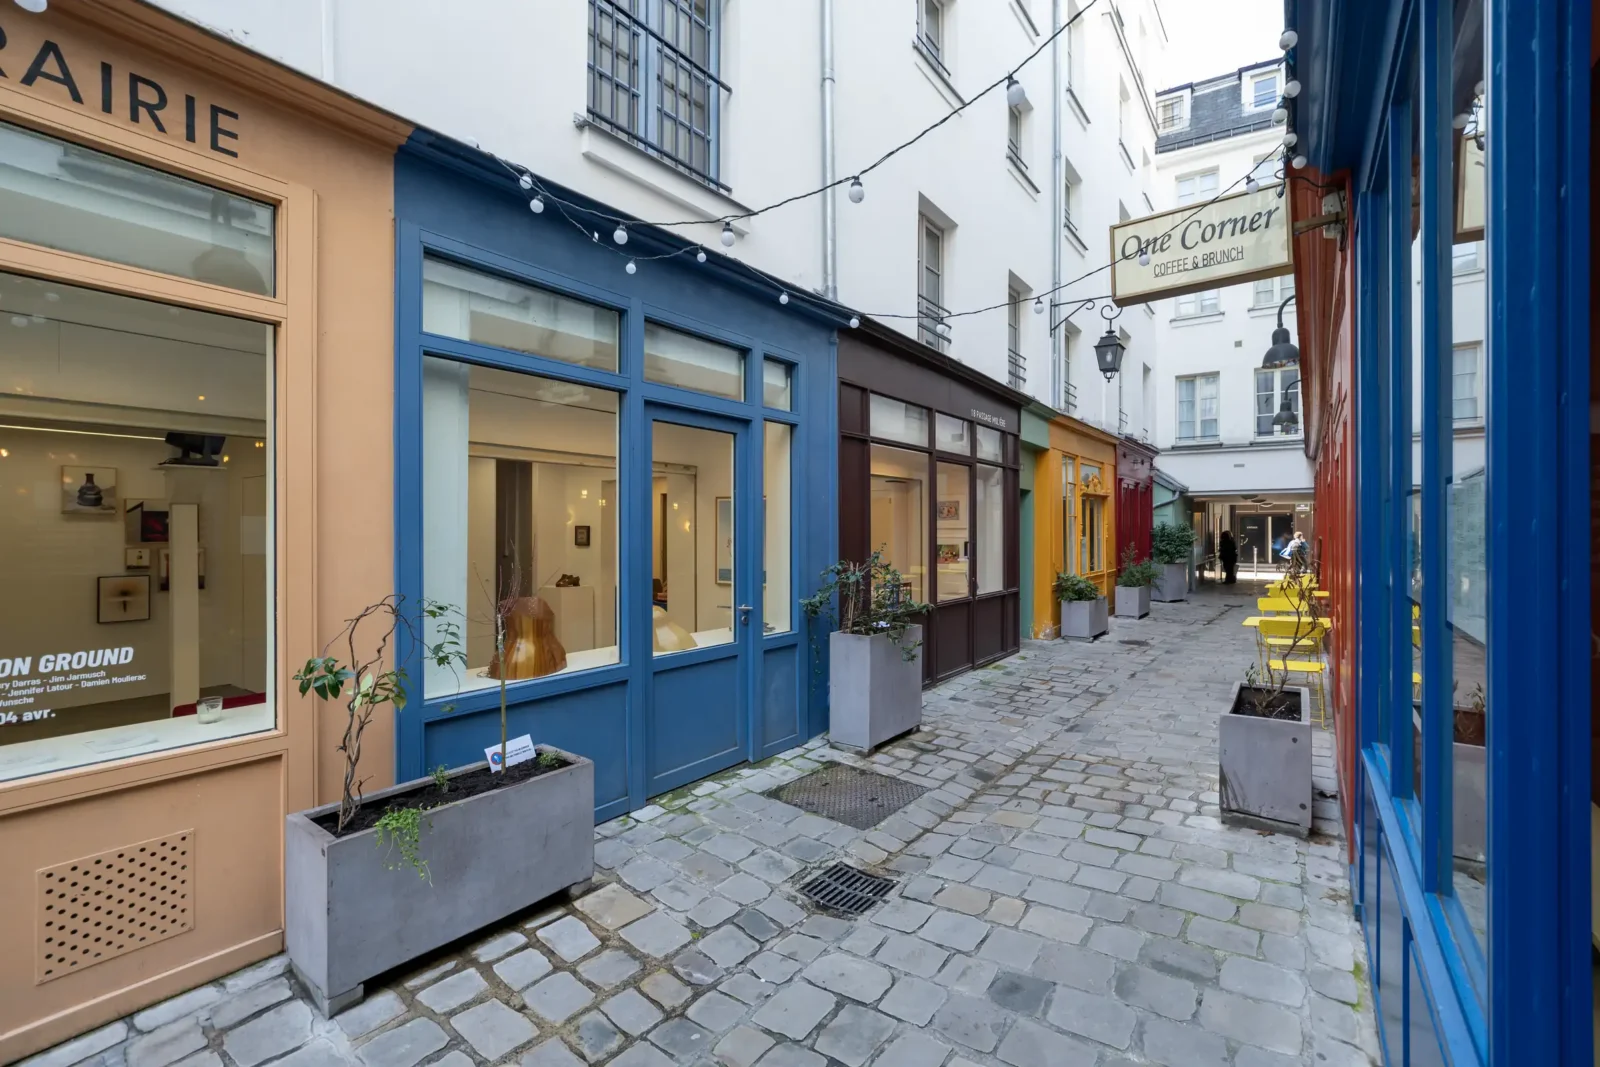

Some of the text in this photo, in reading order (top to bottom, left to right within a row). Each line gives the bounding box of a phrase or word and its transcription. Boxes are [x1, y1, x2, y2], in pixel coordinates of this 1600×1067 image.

[1121, 206, 1280, 261] One Corner
[1153, 246, 1244, 277] COFFEE & BRUNCH
[0, 647, 134, 678] ON GROUND
[8, 687, 45, 697] Jennifer
[46, 683, 73, 693] Latour
[81, 678, 110, 688] Damien
[12, 679, 41, 688] Darras
[49, 675, 65, 683] Jim
[66, 670, 106, 681] Jarmusch
[22, 708, 56, 722] avr.
